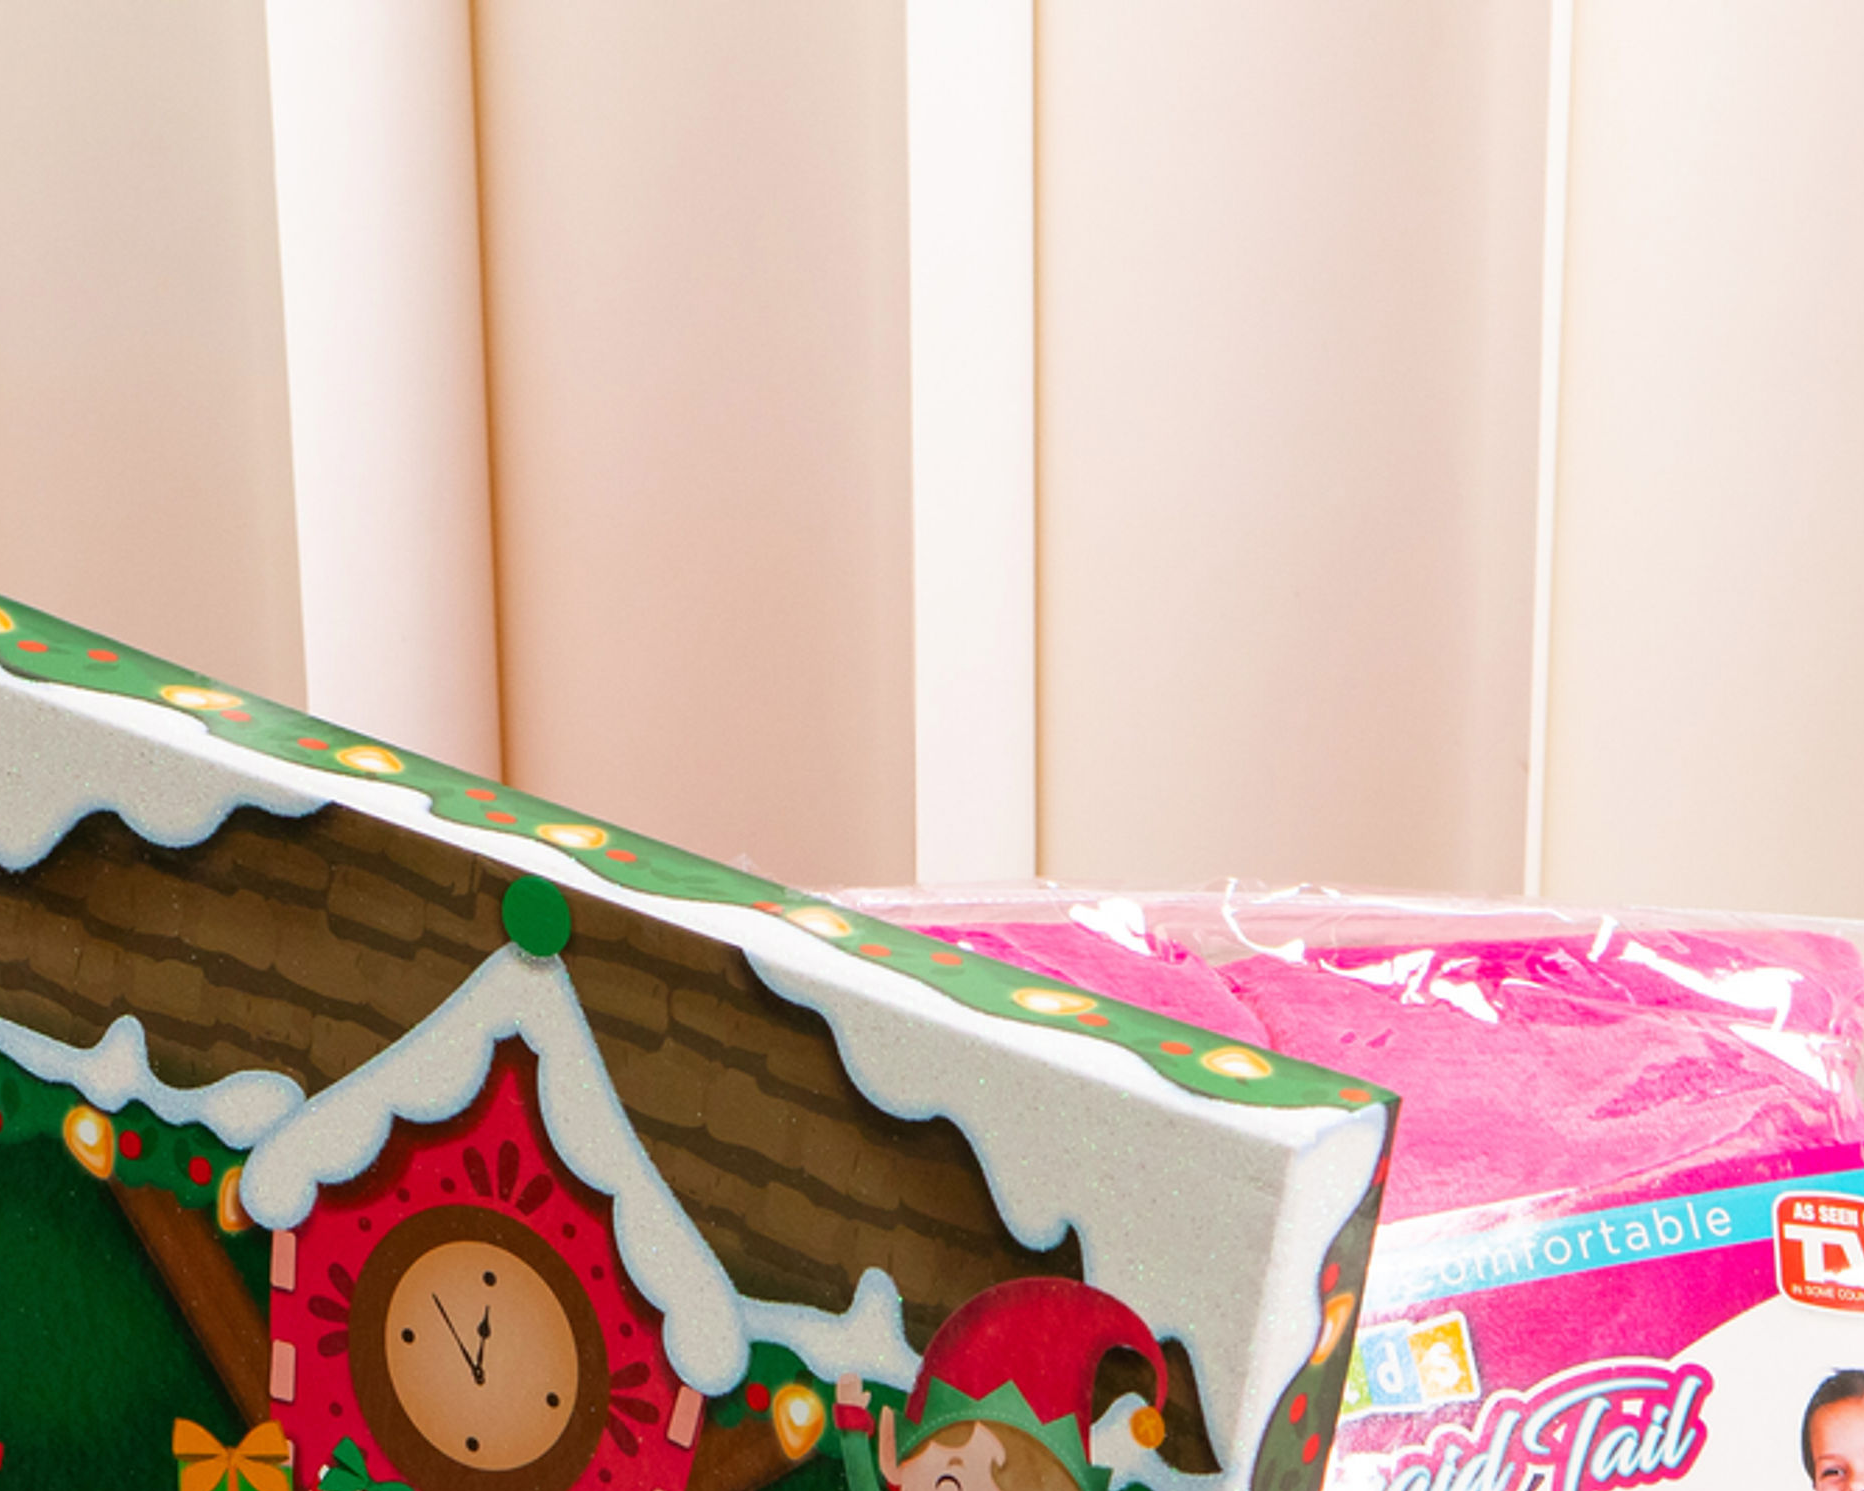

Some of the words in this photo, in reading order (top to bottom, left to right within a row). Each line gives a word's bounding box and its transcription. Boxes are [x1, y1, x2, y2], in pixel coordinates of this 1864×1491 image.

[1792, 1202, 1816, 1222] AS
[1818, 1204, 1859, 1228] SEEN
[1790, 1283, 1803, 1295] IN
[1804, 1285, 1836, 1299] SOME
